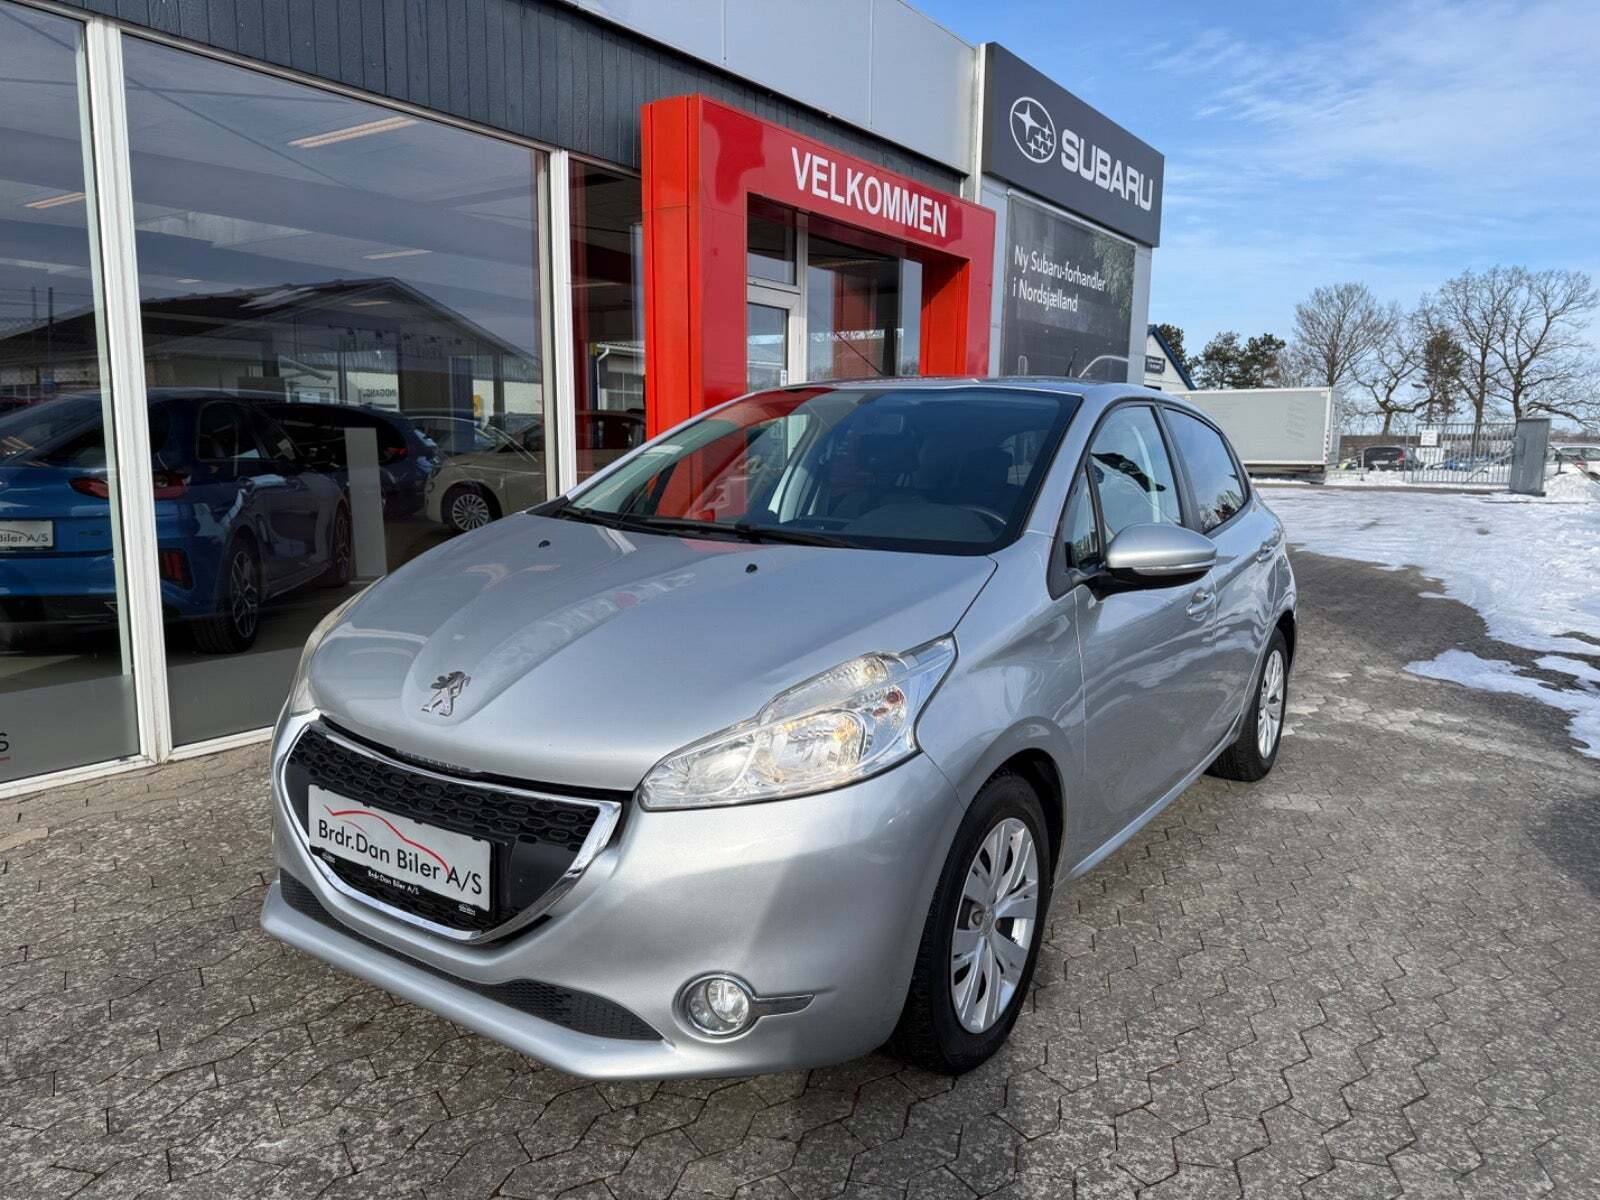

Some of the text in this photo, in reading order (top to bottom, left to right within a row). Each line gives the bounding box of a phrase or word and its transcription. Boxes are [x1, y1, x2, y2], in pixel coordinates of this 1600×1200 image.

[791, 147, 947, 238] VELKOMMEN
[1061, 129, 1153, 211] SUBARU
[1014, 244, 1106, 292] Ny Subaru-forhandler
[1012, 277, 1079, 312] i Nordsjælland
[397, 848, 440, 879] Biler
[446, 866, 482, 895] A/S
